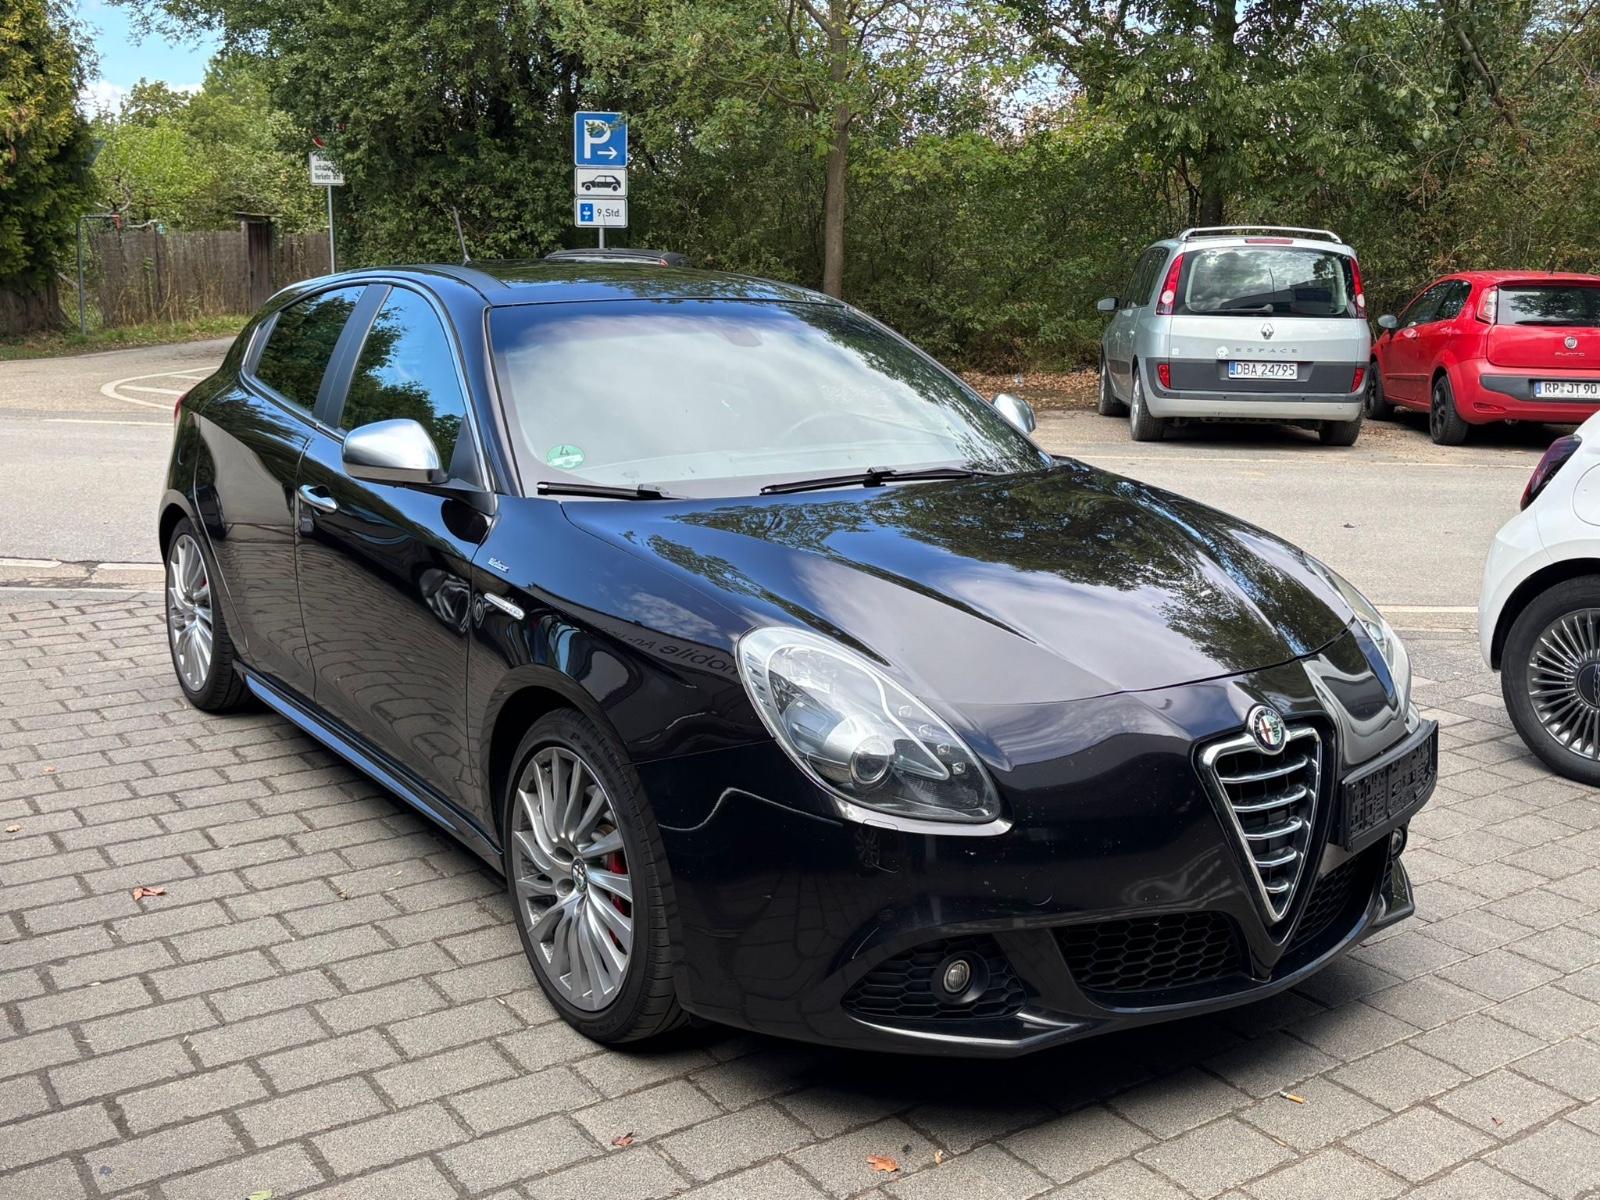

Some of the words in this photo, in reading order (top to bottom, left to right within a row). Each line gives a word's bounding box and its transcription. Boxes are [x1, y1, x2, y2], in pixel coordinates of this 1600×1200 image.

[583, 119, 611, 159] P
[597, 208, 602, 217] 9
[1236, 363, 1257, 375] DBA
[1261, 363, 1295, 376] 24795
[1545, 383, 1559, 393] RP
[1567, 383, 1581, 394] JT
